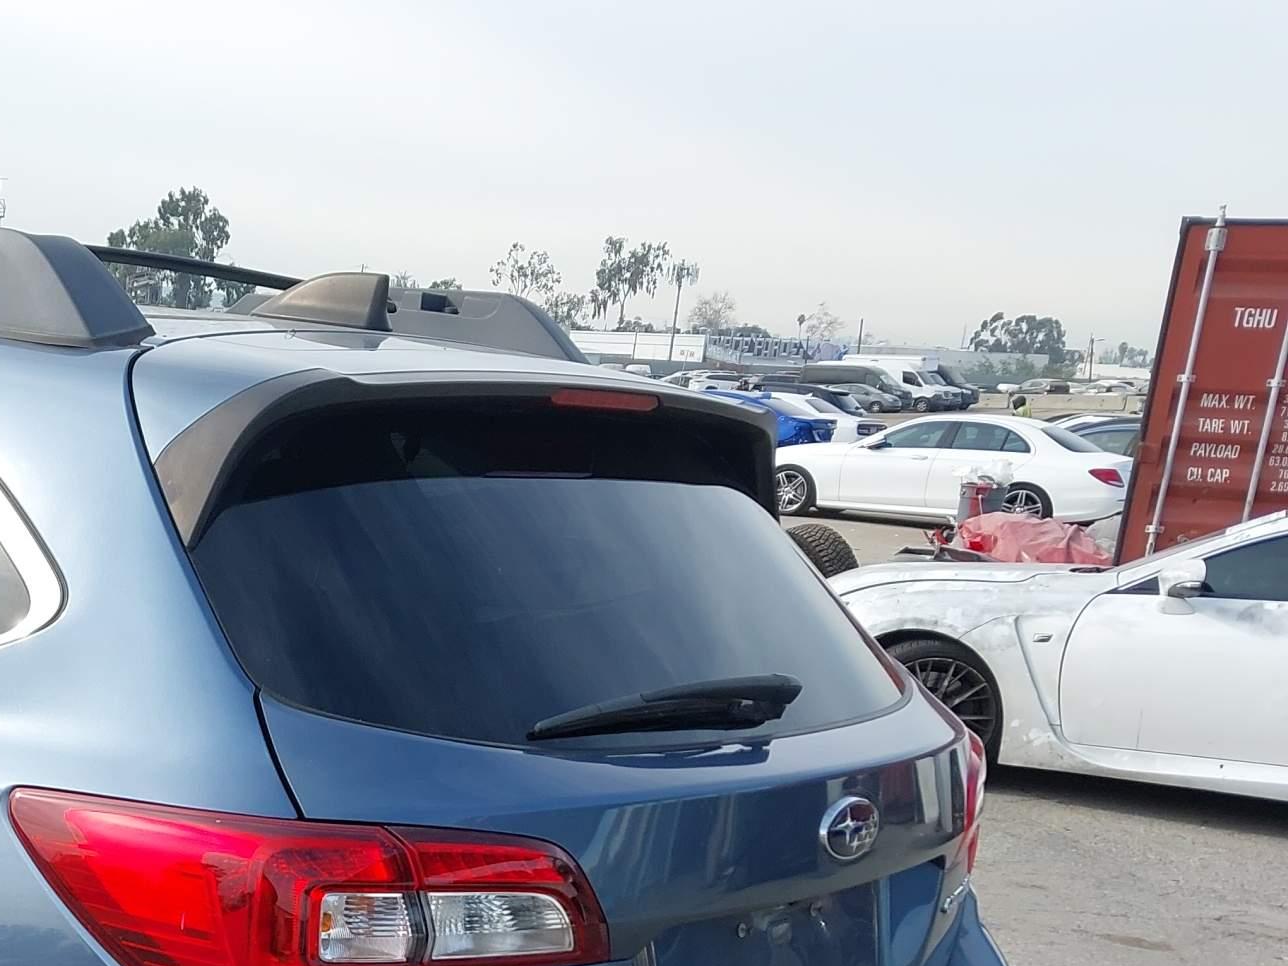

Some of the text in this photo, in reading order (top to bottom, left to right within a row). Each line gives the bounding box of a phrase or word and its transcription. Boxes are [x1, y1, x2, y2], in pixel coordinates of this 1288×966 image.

[1234, 306, 1279, 329] TGHU
[1200, 393, 1257, 410] MAX. WT.
[1198, 418, 1252, 435] TARE WT.
[1190, 442, 1241, 459] PAYLOAD
[1207, 467, 1231, 484] CAP.
